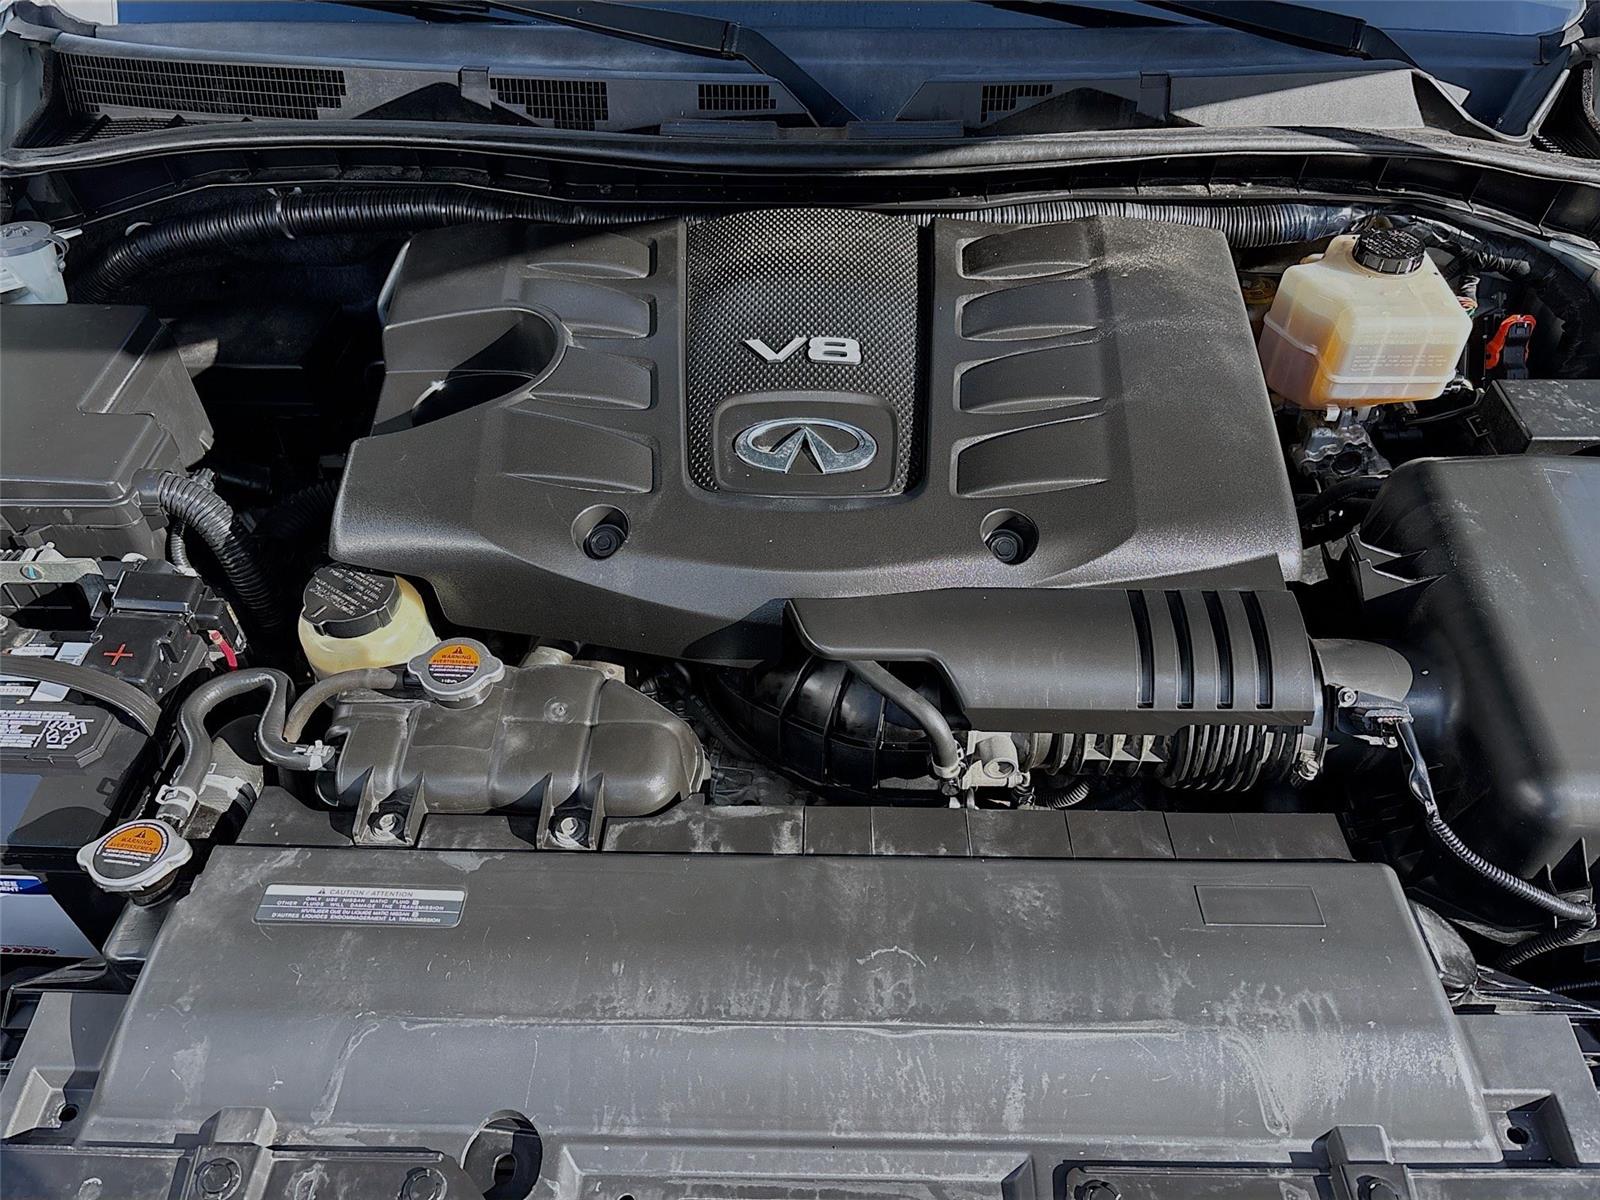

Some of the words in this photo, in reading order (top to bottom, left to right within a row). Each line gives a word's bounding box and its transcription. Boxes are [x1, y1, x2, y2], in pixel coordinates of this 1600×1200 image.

[742, 336, 863, 365] V8
[121, 837, 153, 846] WARNING
[110, 842, 157, 852] AVERTISSEMENT
